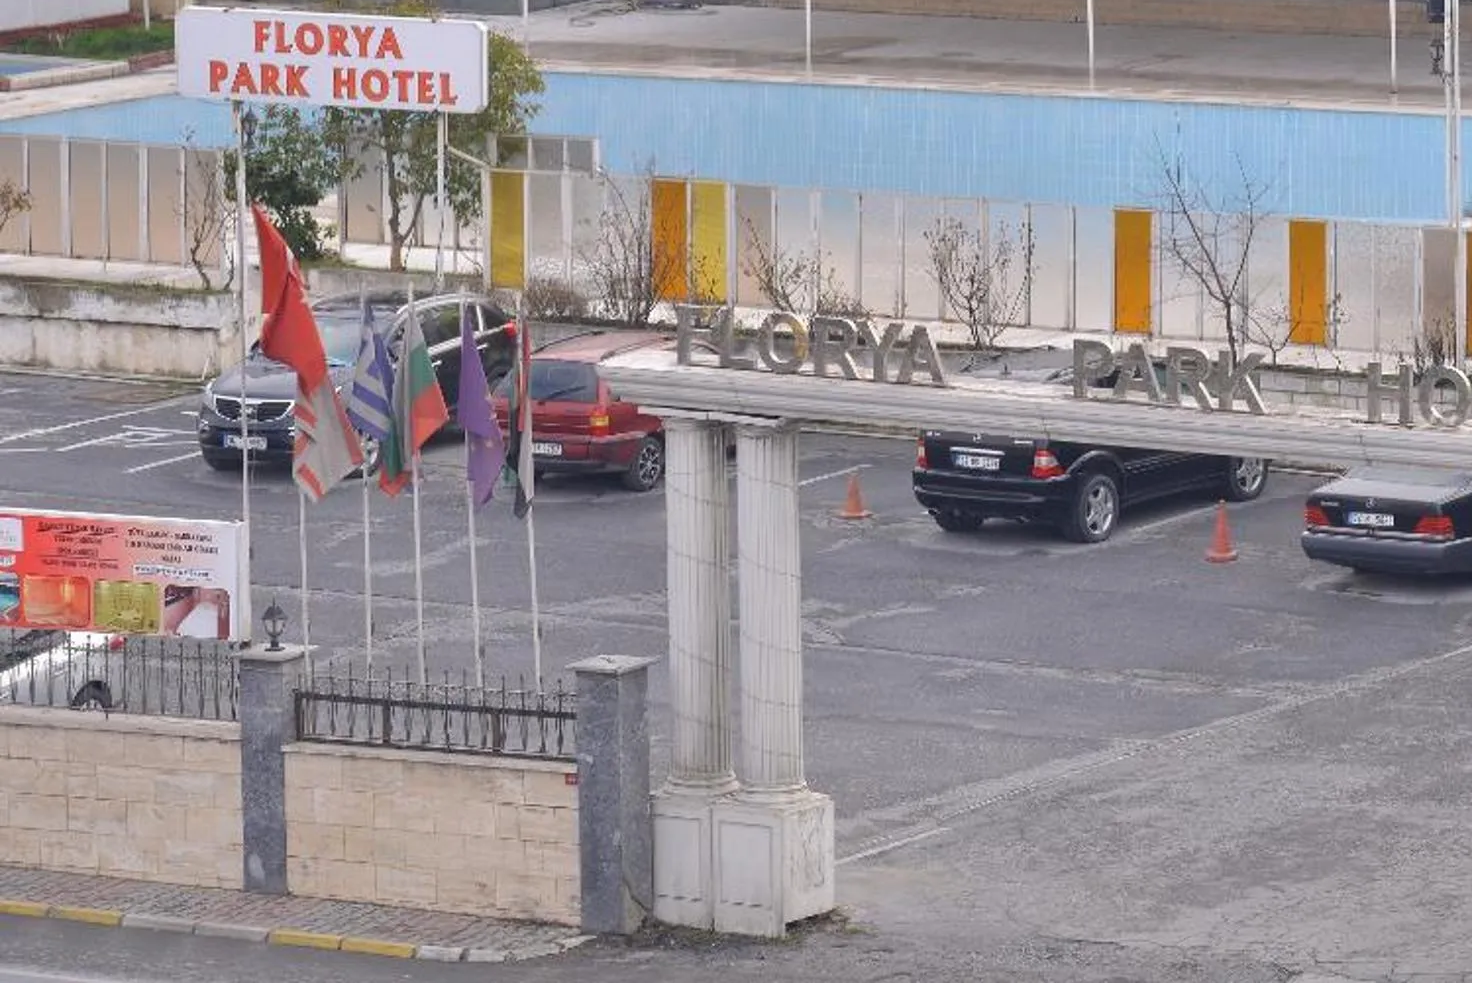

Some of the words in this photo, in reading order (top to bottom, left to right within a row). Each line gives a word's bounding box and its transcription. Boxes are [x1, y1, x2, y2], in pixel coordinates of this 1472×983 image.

[253, 20, 404, 60] FLORYA
[208, 59, 311, 99] PARK
[332, 67, 458, 106] HOTEL
[675, 304, 946, 388] FLORYA
[1072, 338, 1270, 416] PARK
